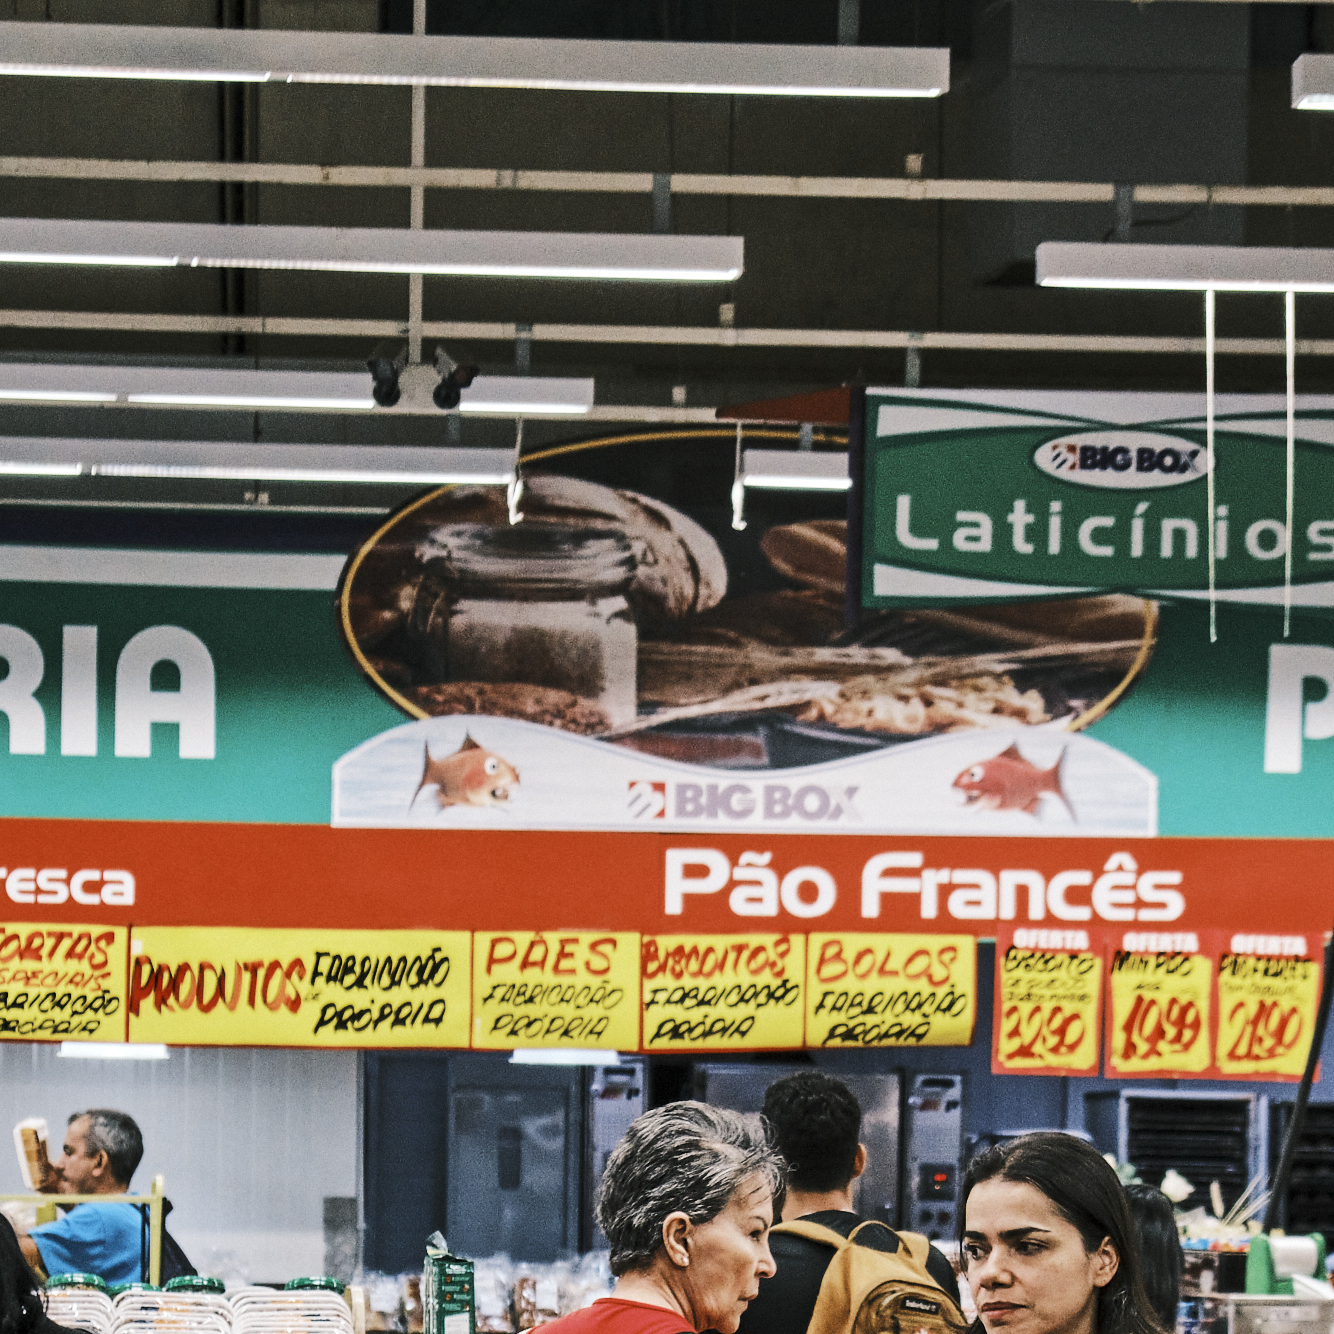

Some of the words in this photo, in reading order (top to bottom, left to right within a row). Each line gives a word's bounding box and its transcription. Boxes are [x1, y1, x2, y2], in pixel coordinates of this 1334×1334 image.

[1078, 445, 1132, 473] BIG
[1135, 447, 1201, 475] BOX
[675, 783, 755, 820] BIG
[764, 785, 860, 823] BOX
[664, 848, 838, 920] Pão
[864, 850, 1186, 923] Francês
[642, 935, 791, 980] BISCOITOS
[816, 940, 957, 988] BOLOS
[129, 954, 307, 1017] PRODUTOS
[482, 980, 624, 1010] FABRICAÇÃO
[815, 984, 966, 1019] FABRICAÇÃO
[313, 999, 447, 1035] PRÓPRIA
[490, 1014, 609, 1040] PRÓPRIA
